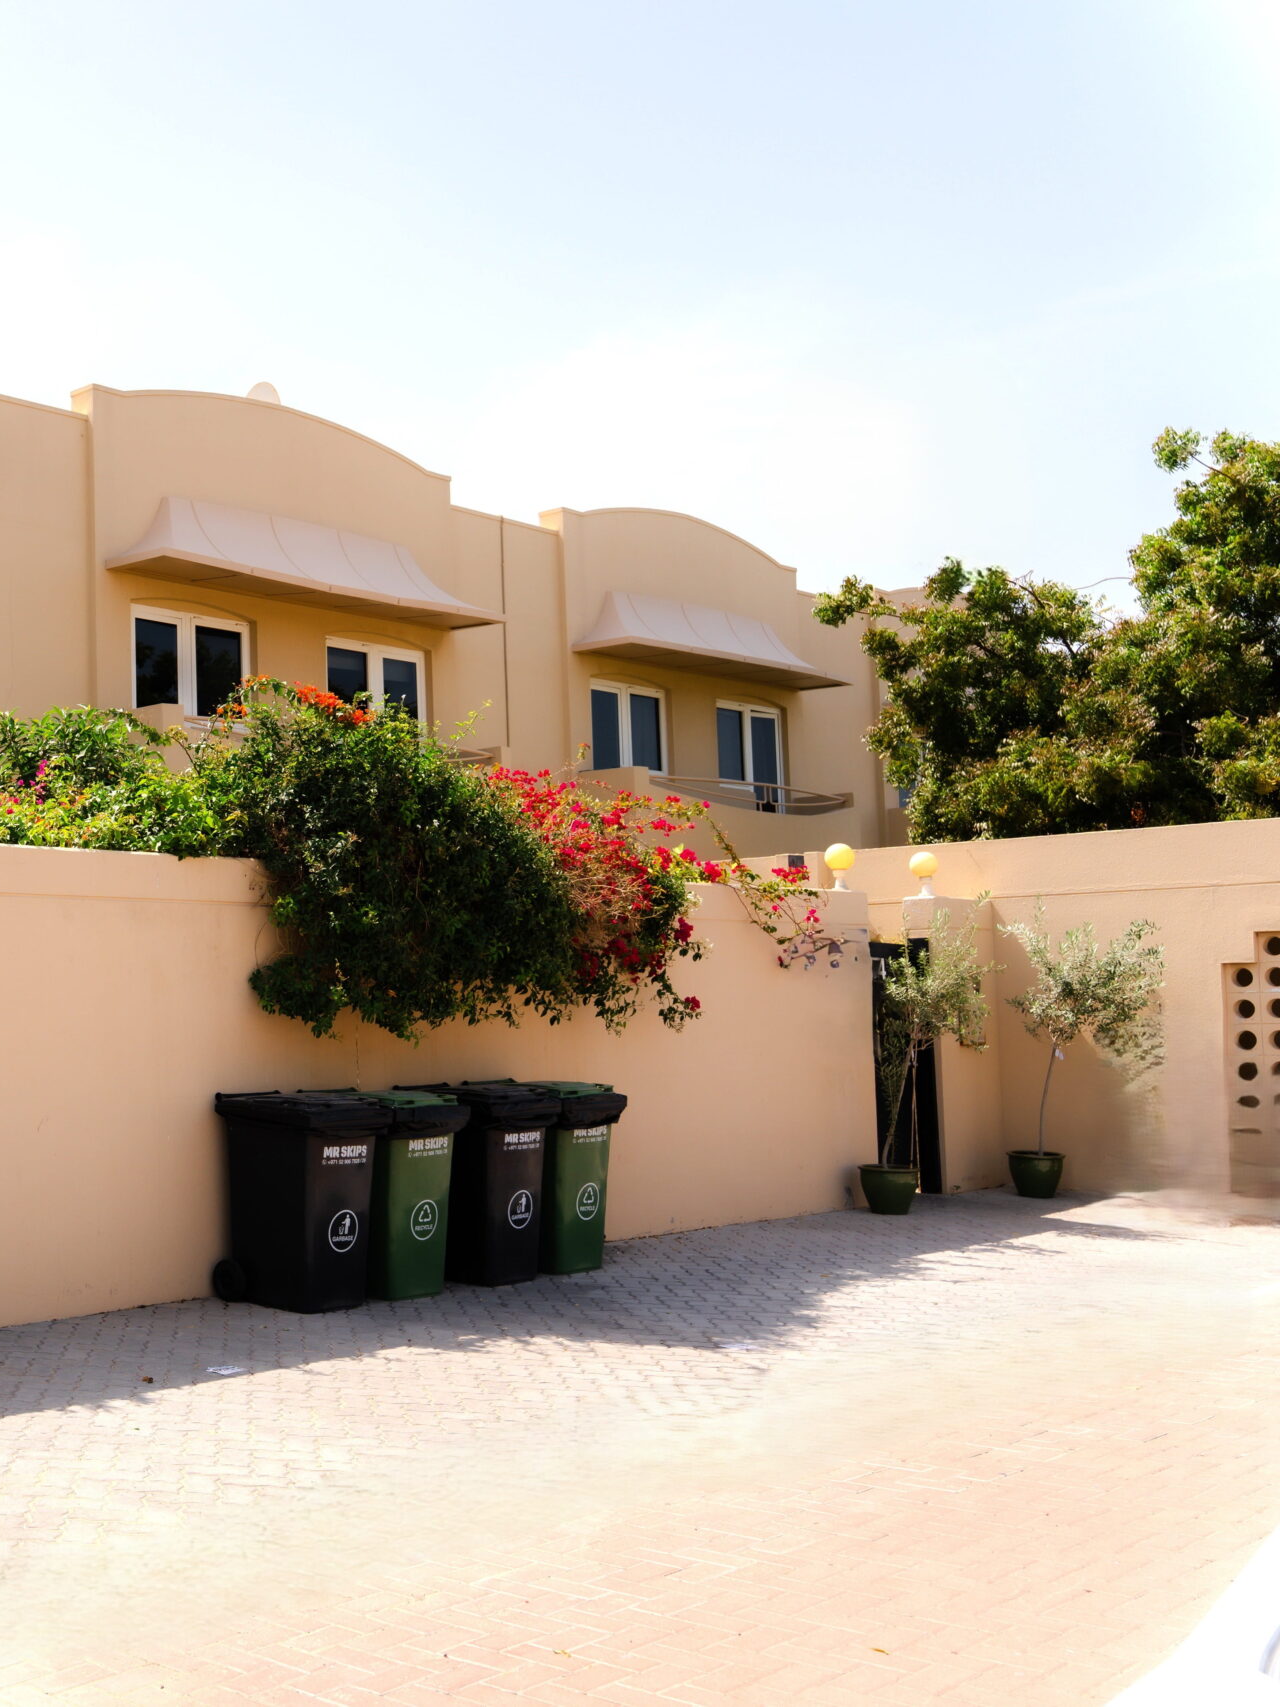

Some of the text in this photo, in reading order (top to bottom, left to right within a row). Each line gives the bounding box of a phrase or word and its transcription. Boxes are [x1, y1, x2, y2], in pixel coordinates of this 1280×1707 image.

[409, 1137, 448, 1150] MR SKIPS
[505, 1131, 540, 1143] MR SKIPS
[323, 1145, 367, 1158] MR SKIPS
